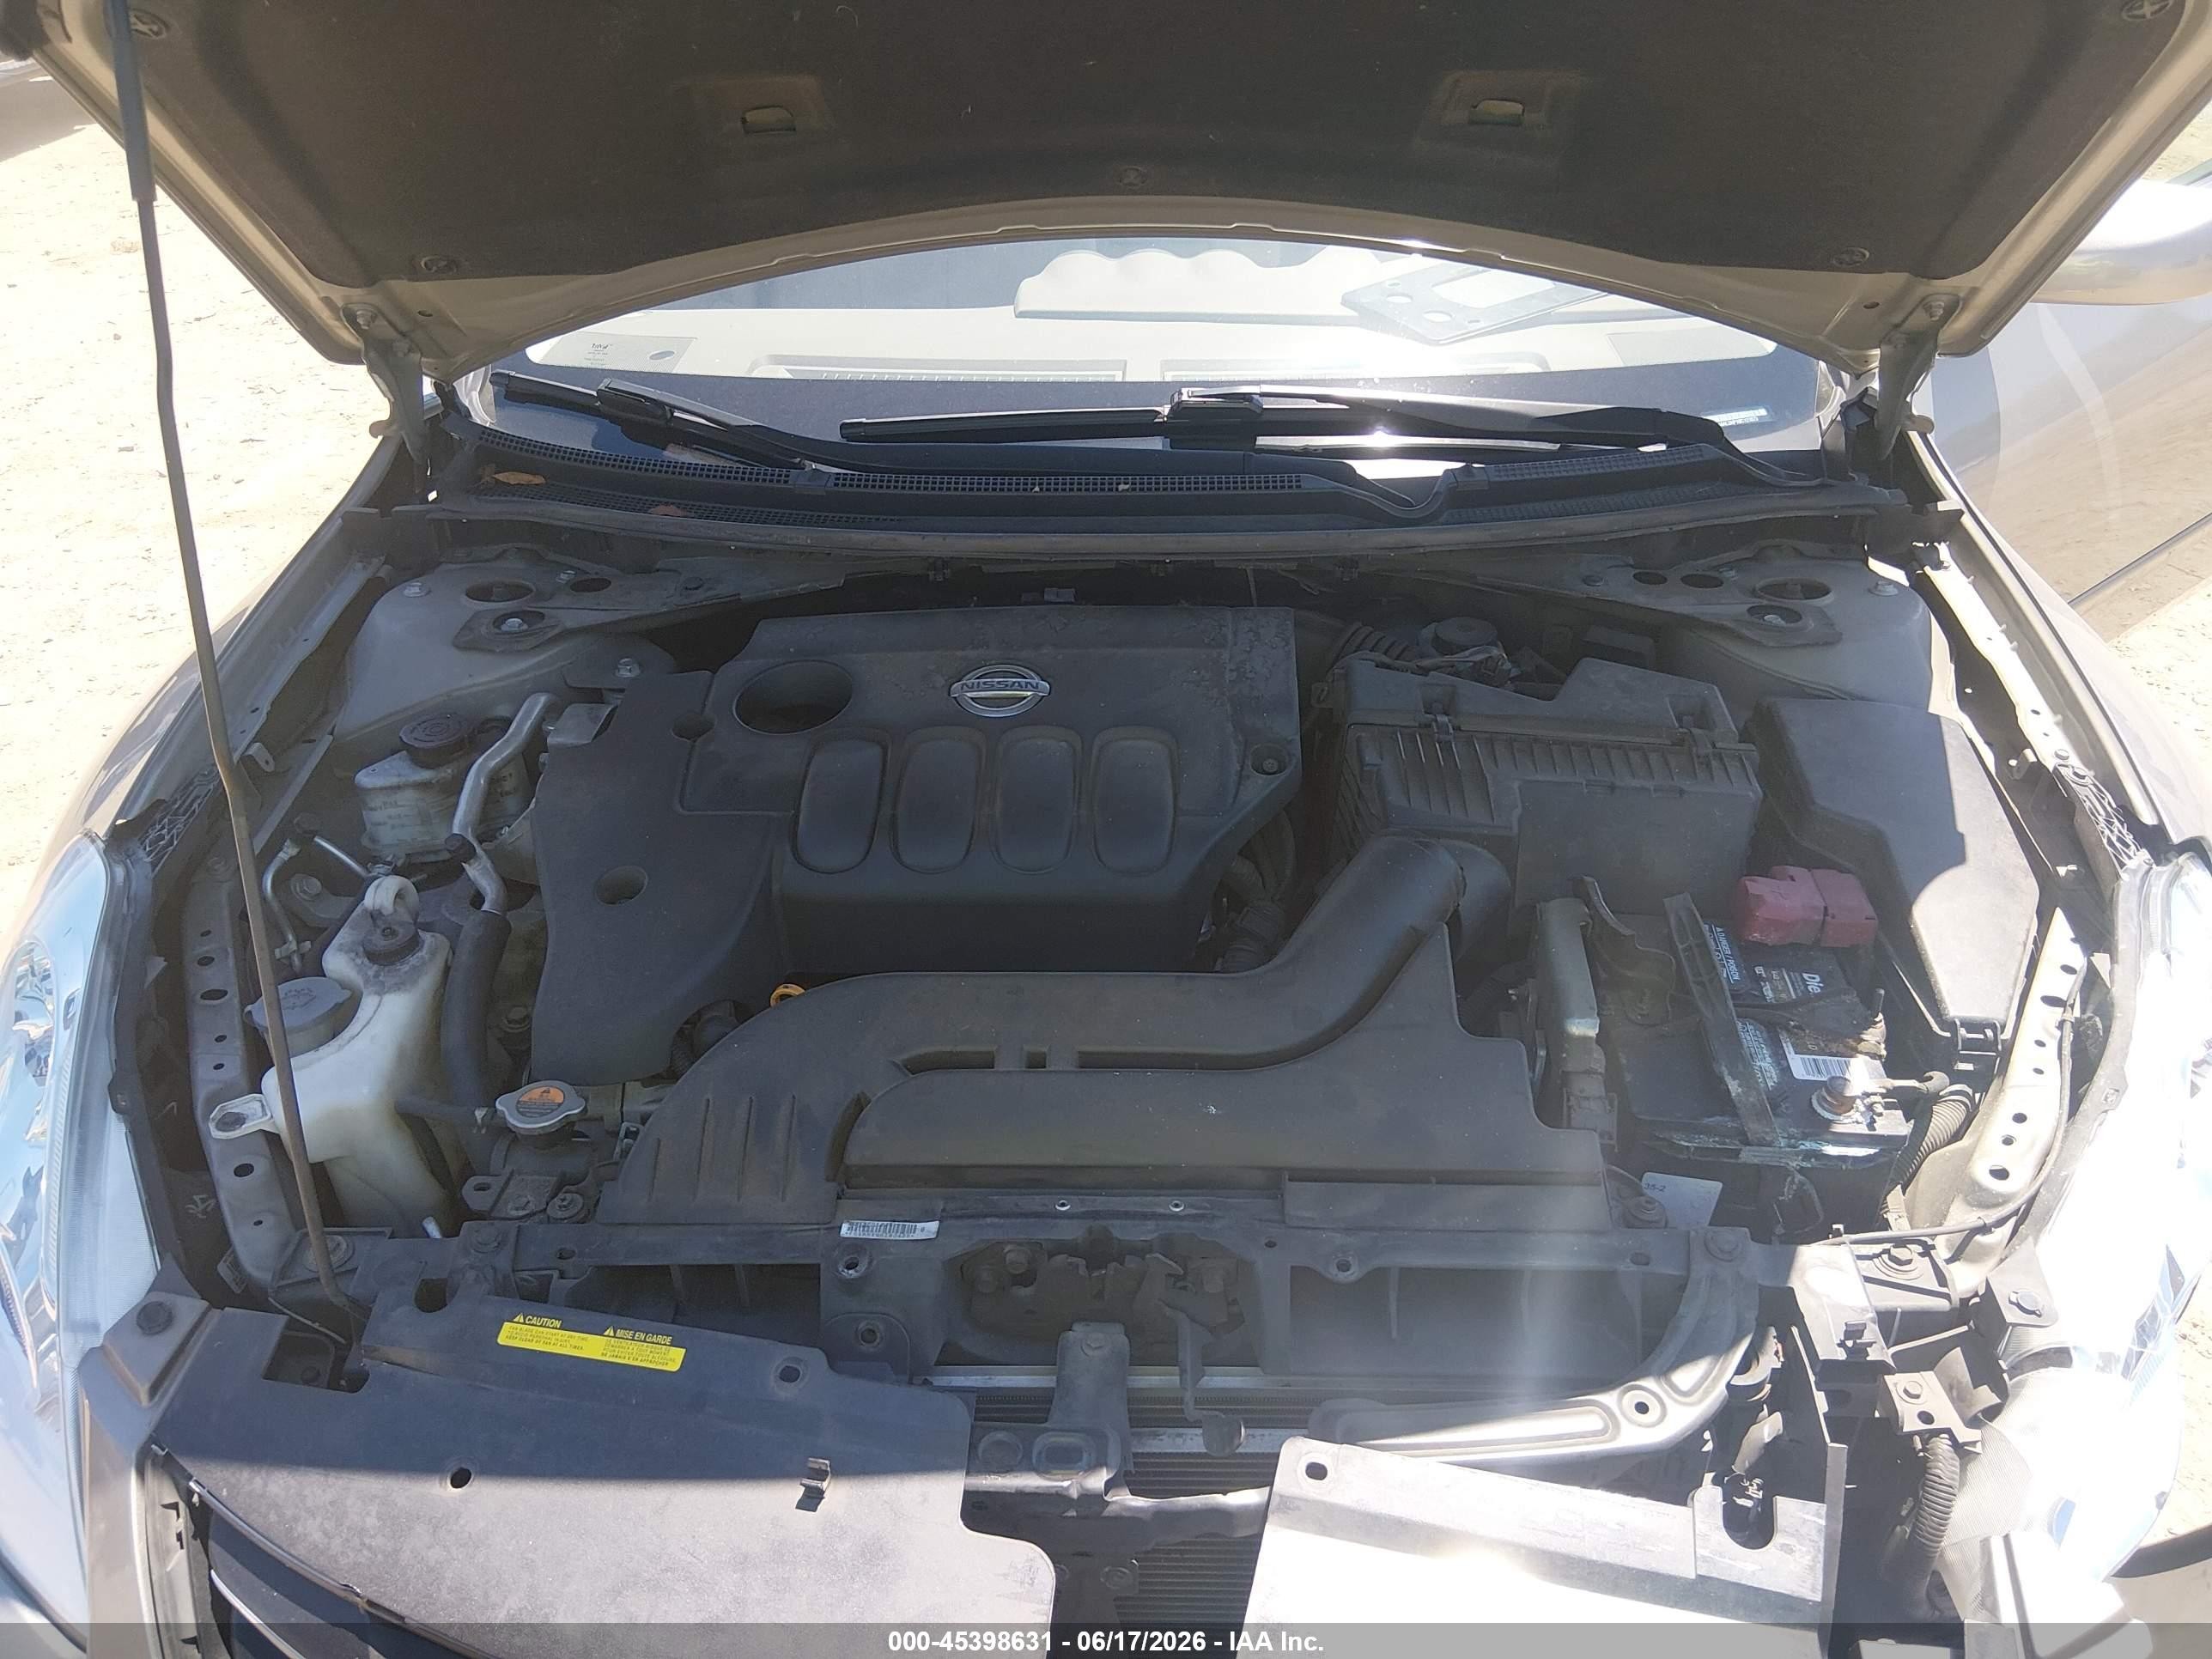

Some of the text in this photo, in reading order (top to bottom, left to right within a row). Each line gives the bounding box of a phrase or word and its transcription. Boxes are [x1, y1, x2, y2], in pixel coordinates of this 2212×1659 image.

[961, 680, 1039, 690] NISSAN
[526, 1316, 562, 1328] CAUTION
[616, 1329, 672, 1345] MISE EN GARDE
